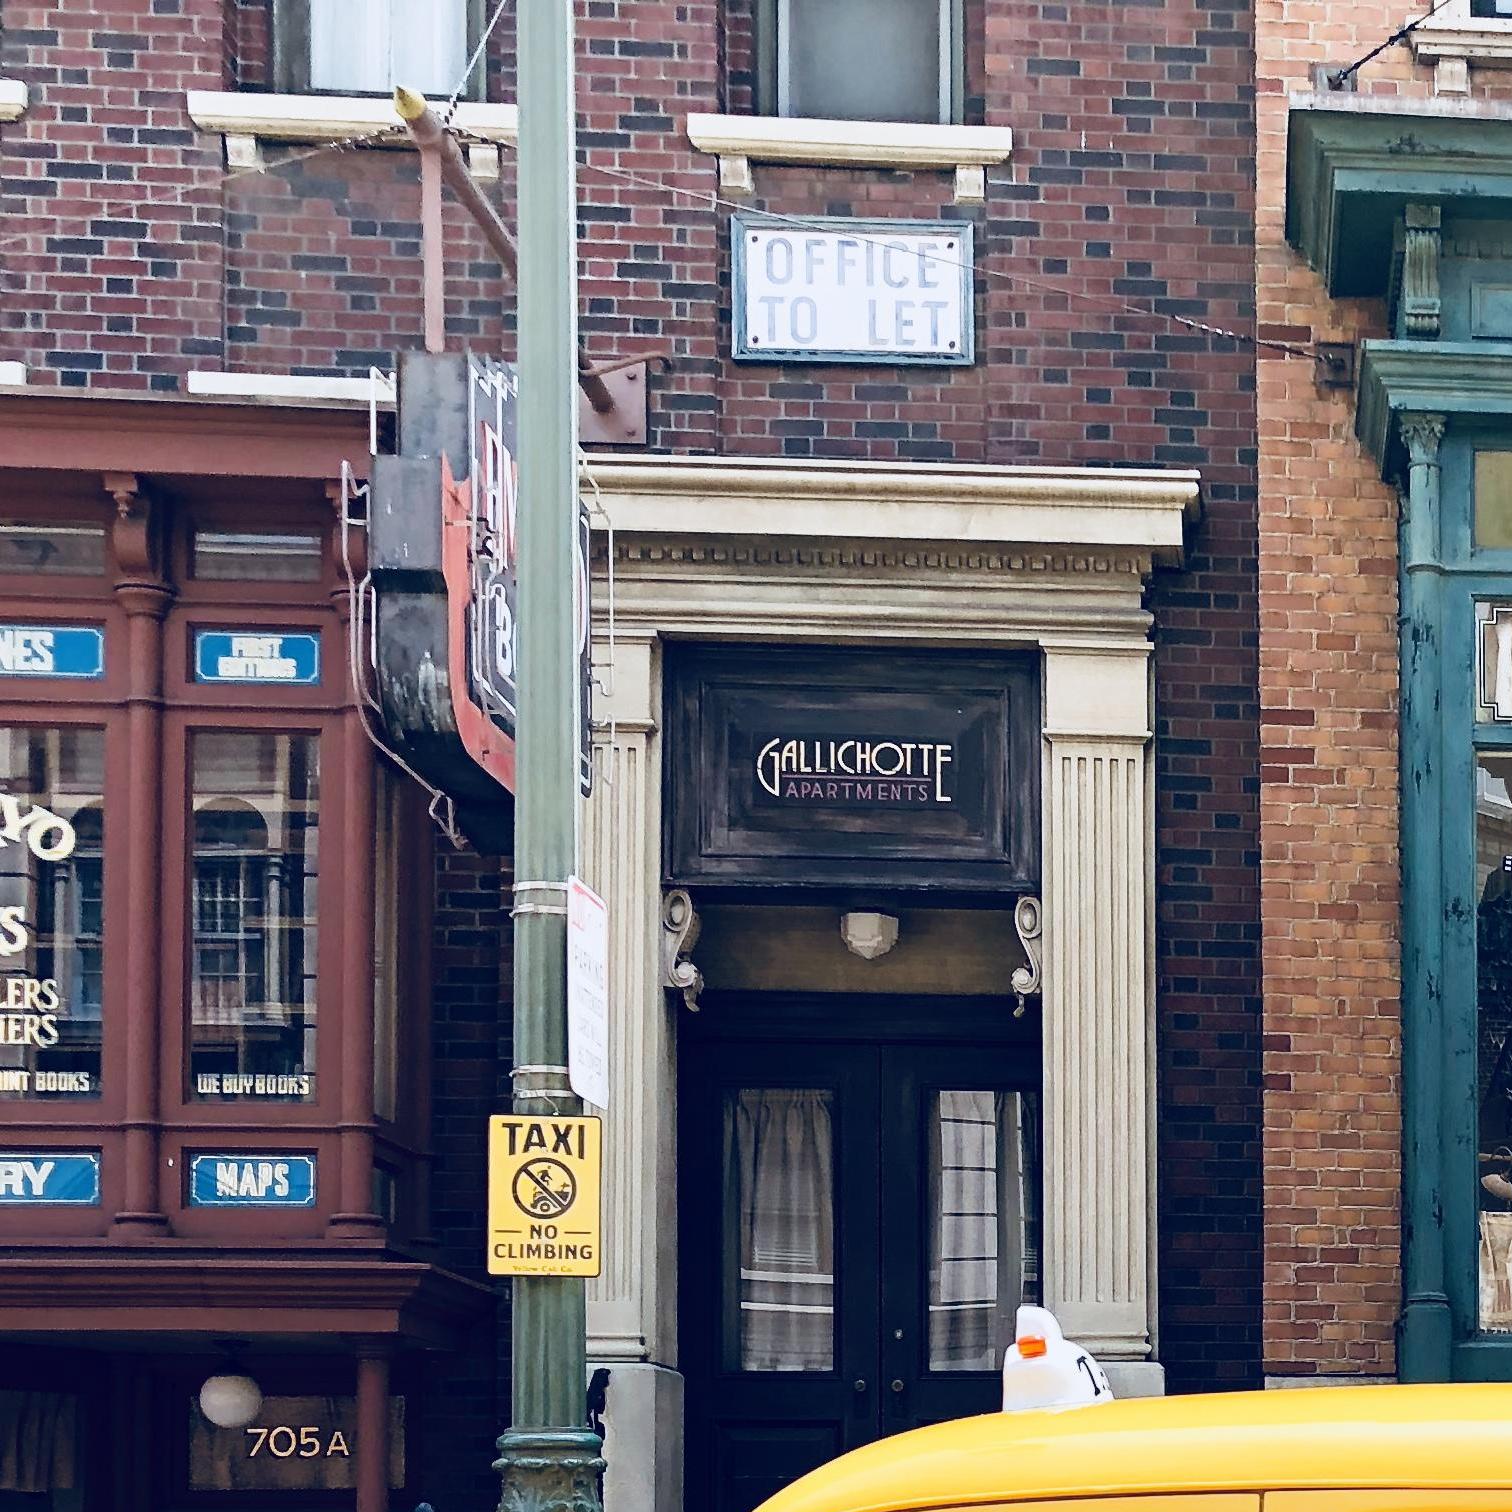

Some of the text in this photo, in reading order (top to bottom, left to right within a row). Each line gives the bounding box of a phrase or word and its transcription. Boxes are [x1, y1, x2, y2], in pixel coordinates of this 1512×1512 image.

[766, 237, 939, 288] OFFICE
[758, 296, 949, 347] TO LET
[756, 737, 952, 802] GALLICHOTTE
[786, 782, 928, 802] APARTMENTS
[35, 1072, 90, 1092] BOOKS
[197, 1074, 310, 1095] WE BUY BOOKS
[502, 1122, 585, 1160] TAXI
[216, 1162, 290, 1197] MAPS
[530, 1224, 558, 1240] NO
[494, 1243, 593, 1260] CLIMBING
